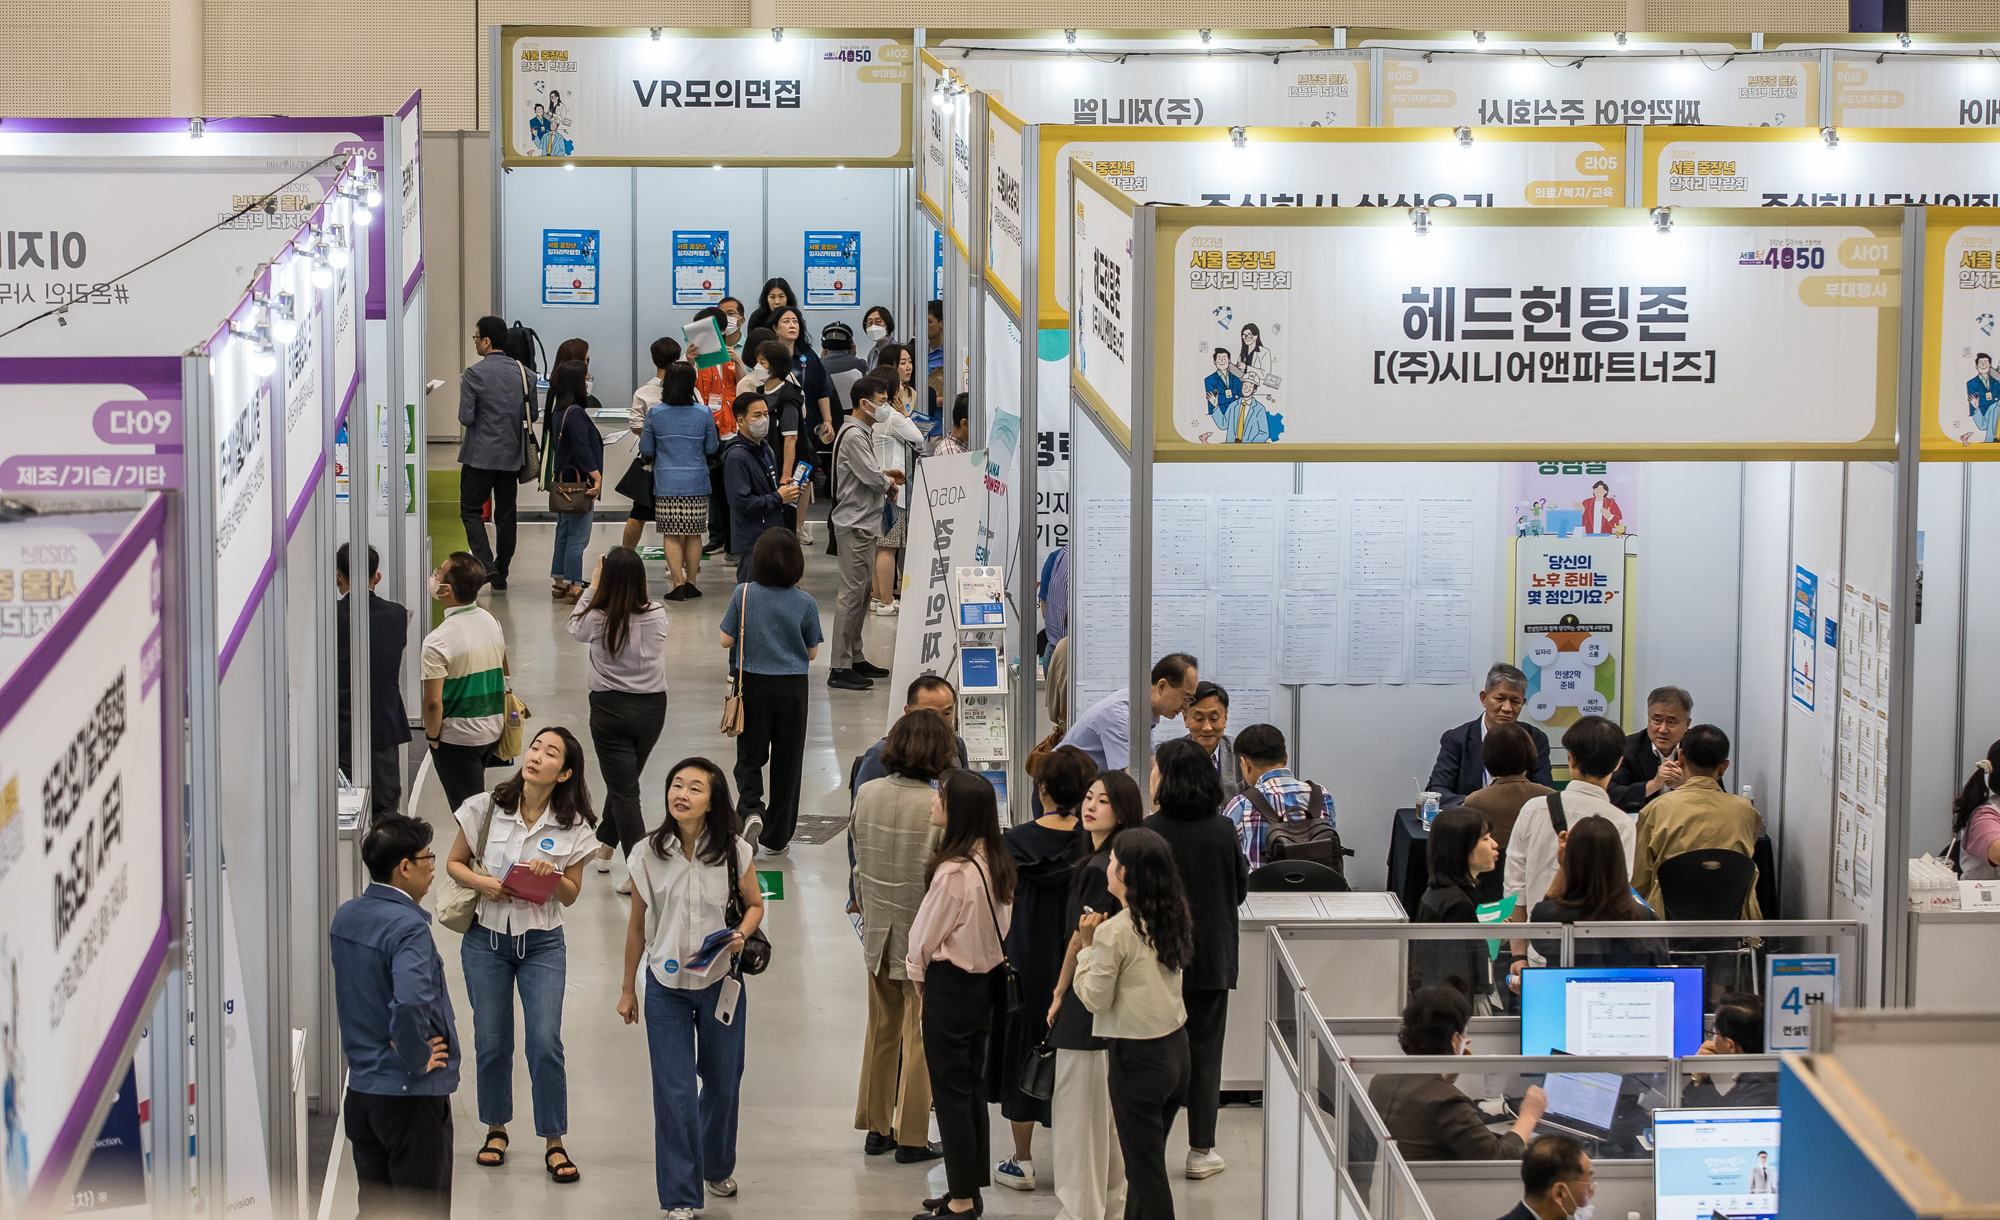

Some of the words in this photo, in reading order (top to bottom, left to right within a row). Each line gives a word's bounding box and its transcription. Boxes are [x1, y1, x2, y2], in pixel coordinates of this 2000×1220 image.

[521, 50, 539, 61] 서울
[541, 50, 569, 61] 중장년
[885, 49, 908, 58] 사02
[521, 61, 548, 72] 일자리
[550, 61, 577, 72] 박람회
[872, 70, 906, 78] 부대행사
[633, 80, 801, 108] VR모의면접
[1096, 161, 1134, 176] 중장년
[1585, 156, 1617, 170] 라05
[1669, 161, 1695, 175] 서울
[1698, 161, 1736, 176] 중장년
[1669, 177, 1709, 192] 일자리
[1710, 177, 1749, 192] 박람회
[1534, 186, 1614, 199] 의료/복지/교육
[1191, 237, 1222, 248] 2023년
[1961, 237, 1993, 248] 2023년
[1190, 251, 1223, 269] 서울
[1226, 251, 1276, 269] 중장년
[1765, 247, 1824, 269] 4050
[1851, 245, 1888, 261] 사01
[1959, 251, 1992, 269] 서울
[1190, 271, 1239, 290] 일자리
[1242, 271, 1292, 290] 박람회
[1825, 283, 1887, 298] 부대행사
[1402, 285, 1689, 342] 헤드헌팅존
[1373, 350, 1716, 384] [(주)시니어앤파트너즈]
[110, 410, 172, 434] 다09
[17, 465, 166, 486] 제조/기술/기타
[1532, 573, 1560, 588] 노후
[1564, 573, 1607, 588] 준비는
[1527, 590, 1542, 605] 몇
[1555, 670, 1581, 679] 인생2막
[1560, 681, 1575, 690] 준비
